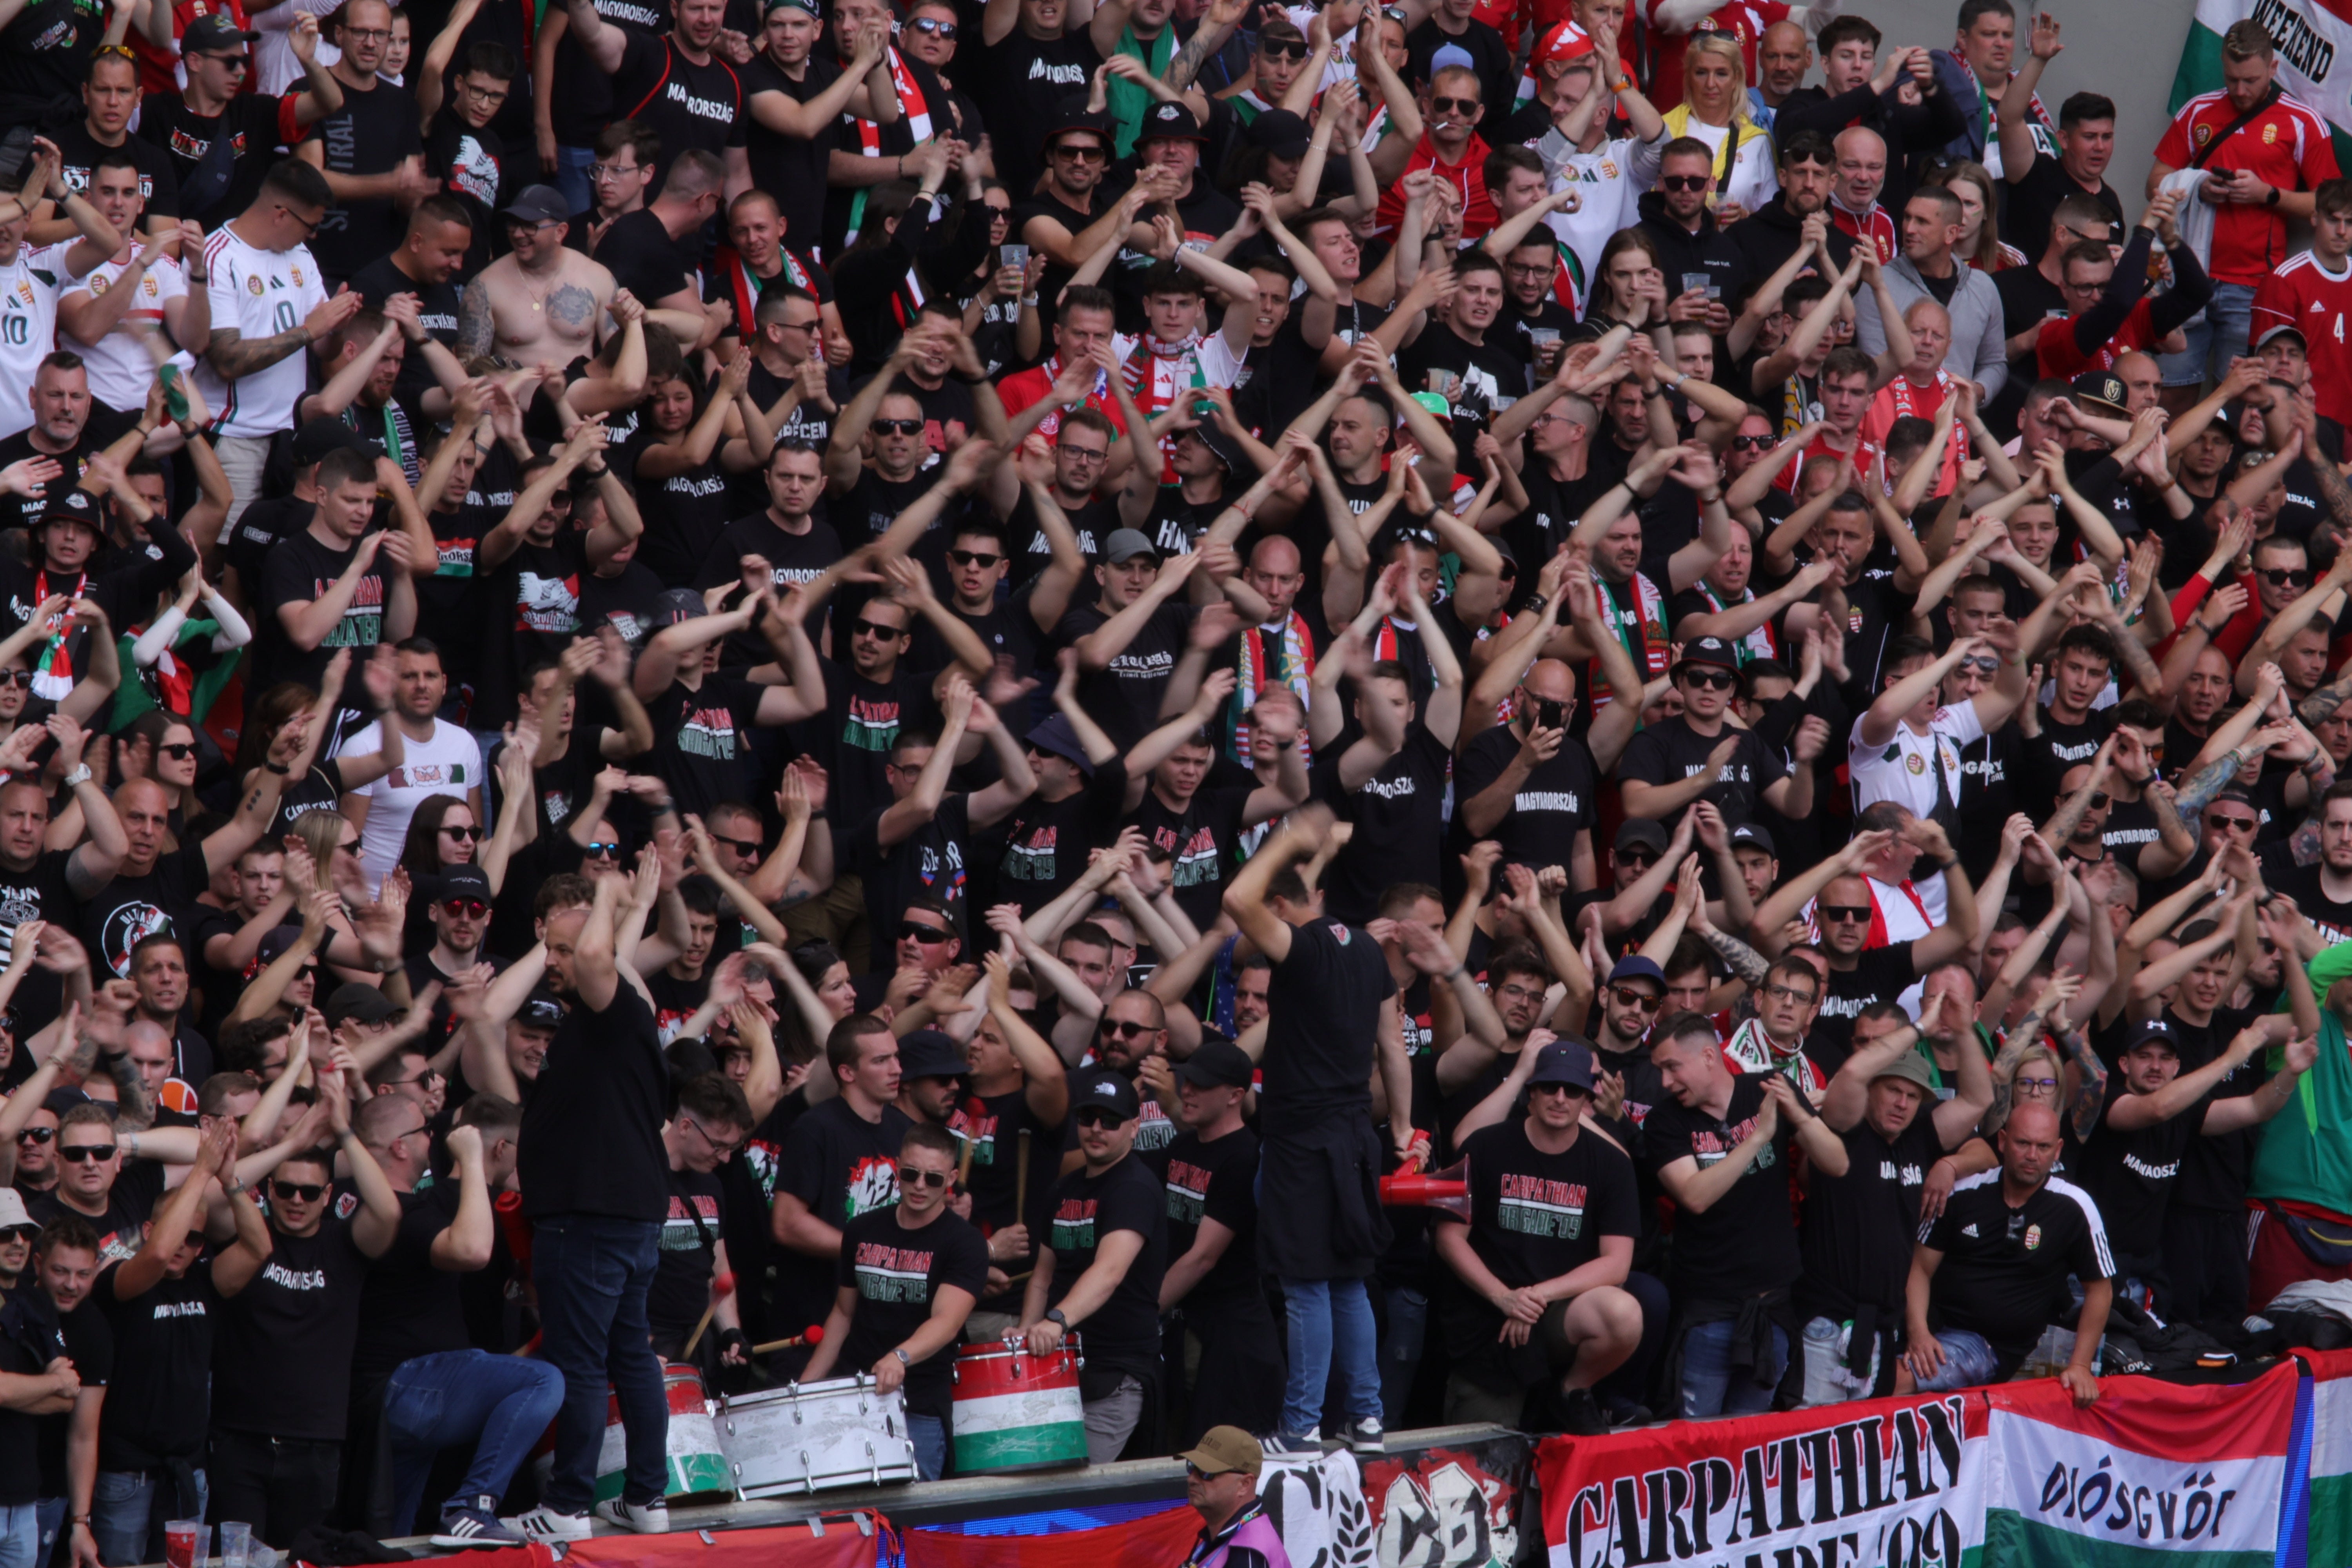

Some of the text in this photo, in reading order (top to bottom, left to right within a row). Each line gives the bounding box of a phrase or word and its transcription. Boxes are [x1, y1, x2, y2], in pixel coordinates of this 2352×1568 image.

[2334, 312, 2345, 344] 4
[1516, 790, 1578, 813] MAGYARORSZÁG
[1500, 1173, 1587, 1209] CARPATHIAN
[1498, 1205, 1583, 1240] BRIGADE'09
[855, 1242, 933, 1273] CARPATHIAN
[1567, 1396, 1965, 1568] CARPATHIAN
